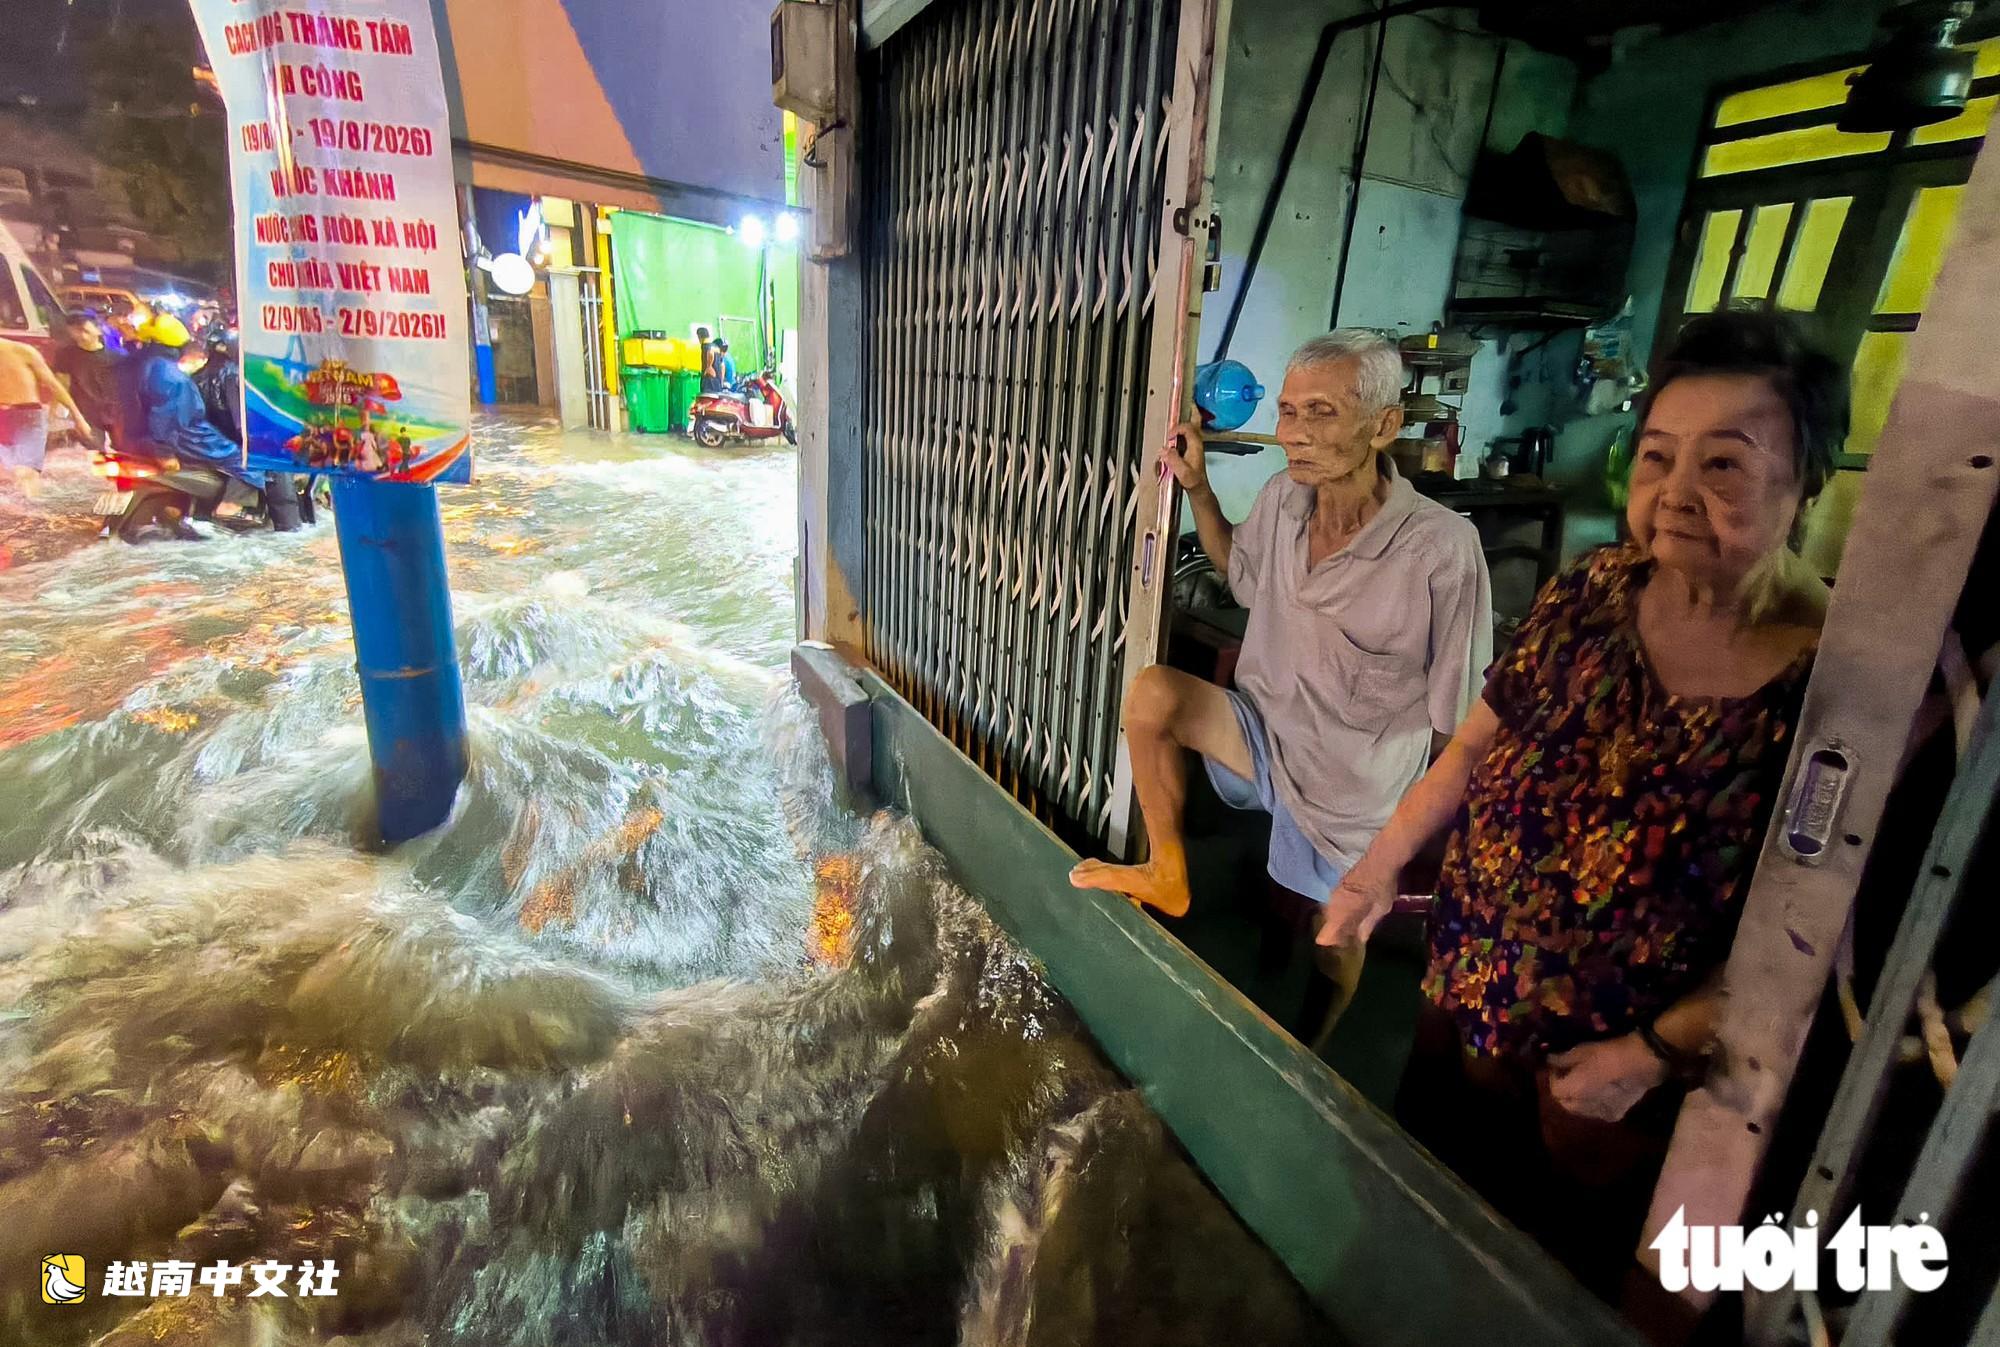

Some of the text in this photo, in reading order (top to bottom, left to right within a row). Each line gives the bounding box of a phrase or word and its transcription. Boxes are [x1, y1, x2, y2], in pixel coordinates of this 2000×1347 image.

[286, 11, 362, 51] THÁNG
[366, 18, 413, 55] TÁM
[300, 62, 363, 101] CÔNG
[308, 118, 432, 156] 19/8/2026)
[324, 166, 395, 200] KHÁNH
[256, 212, 289, 243] NƯỚC
[322, 213, 368, 245] HÒA
[403, 218, 437, 255] HỘI
[336, 260, 381, 296] VIỆT
[388, 266, 430, 294] NAM
[339, 307, 446, 339] 2/9/2026)!
